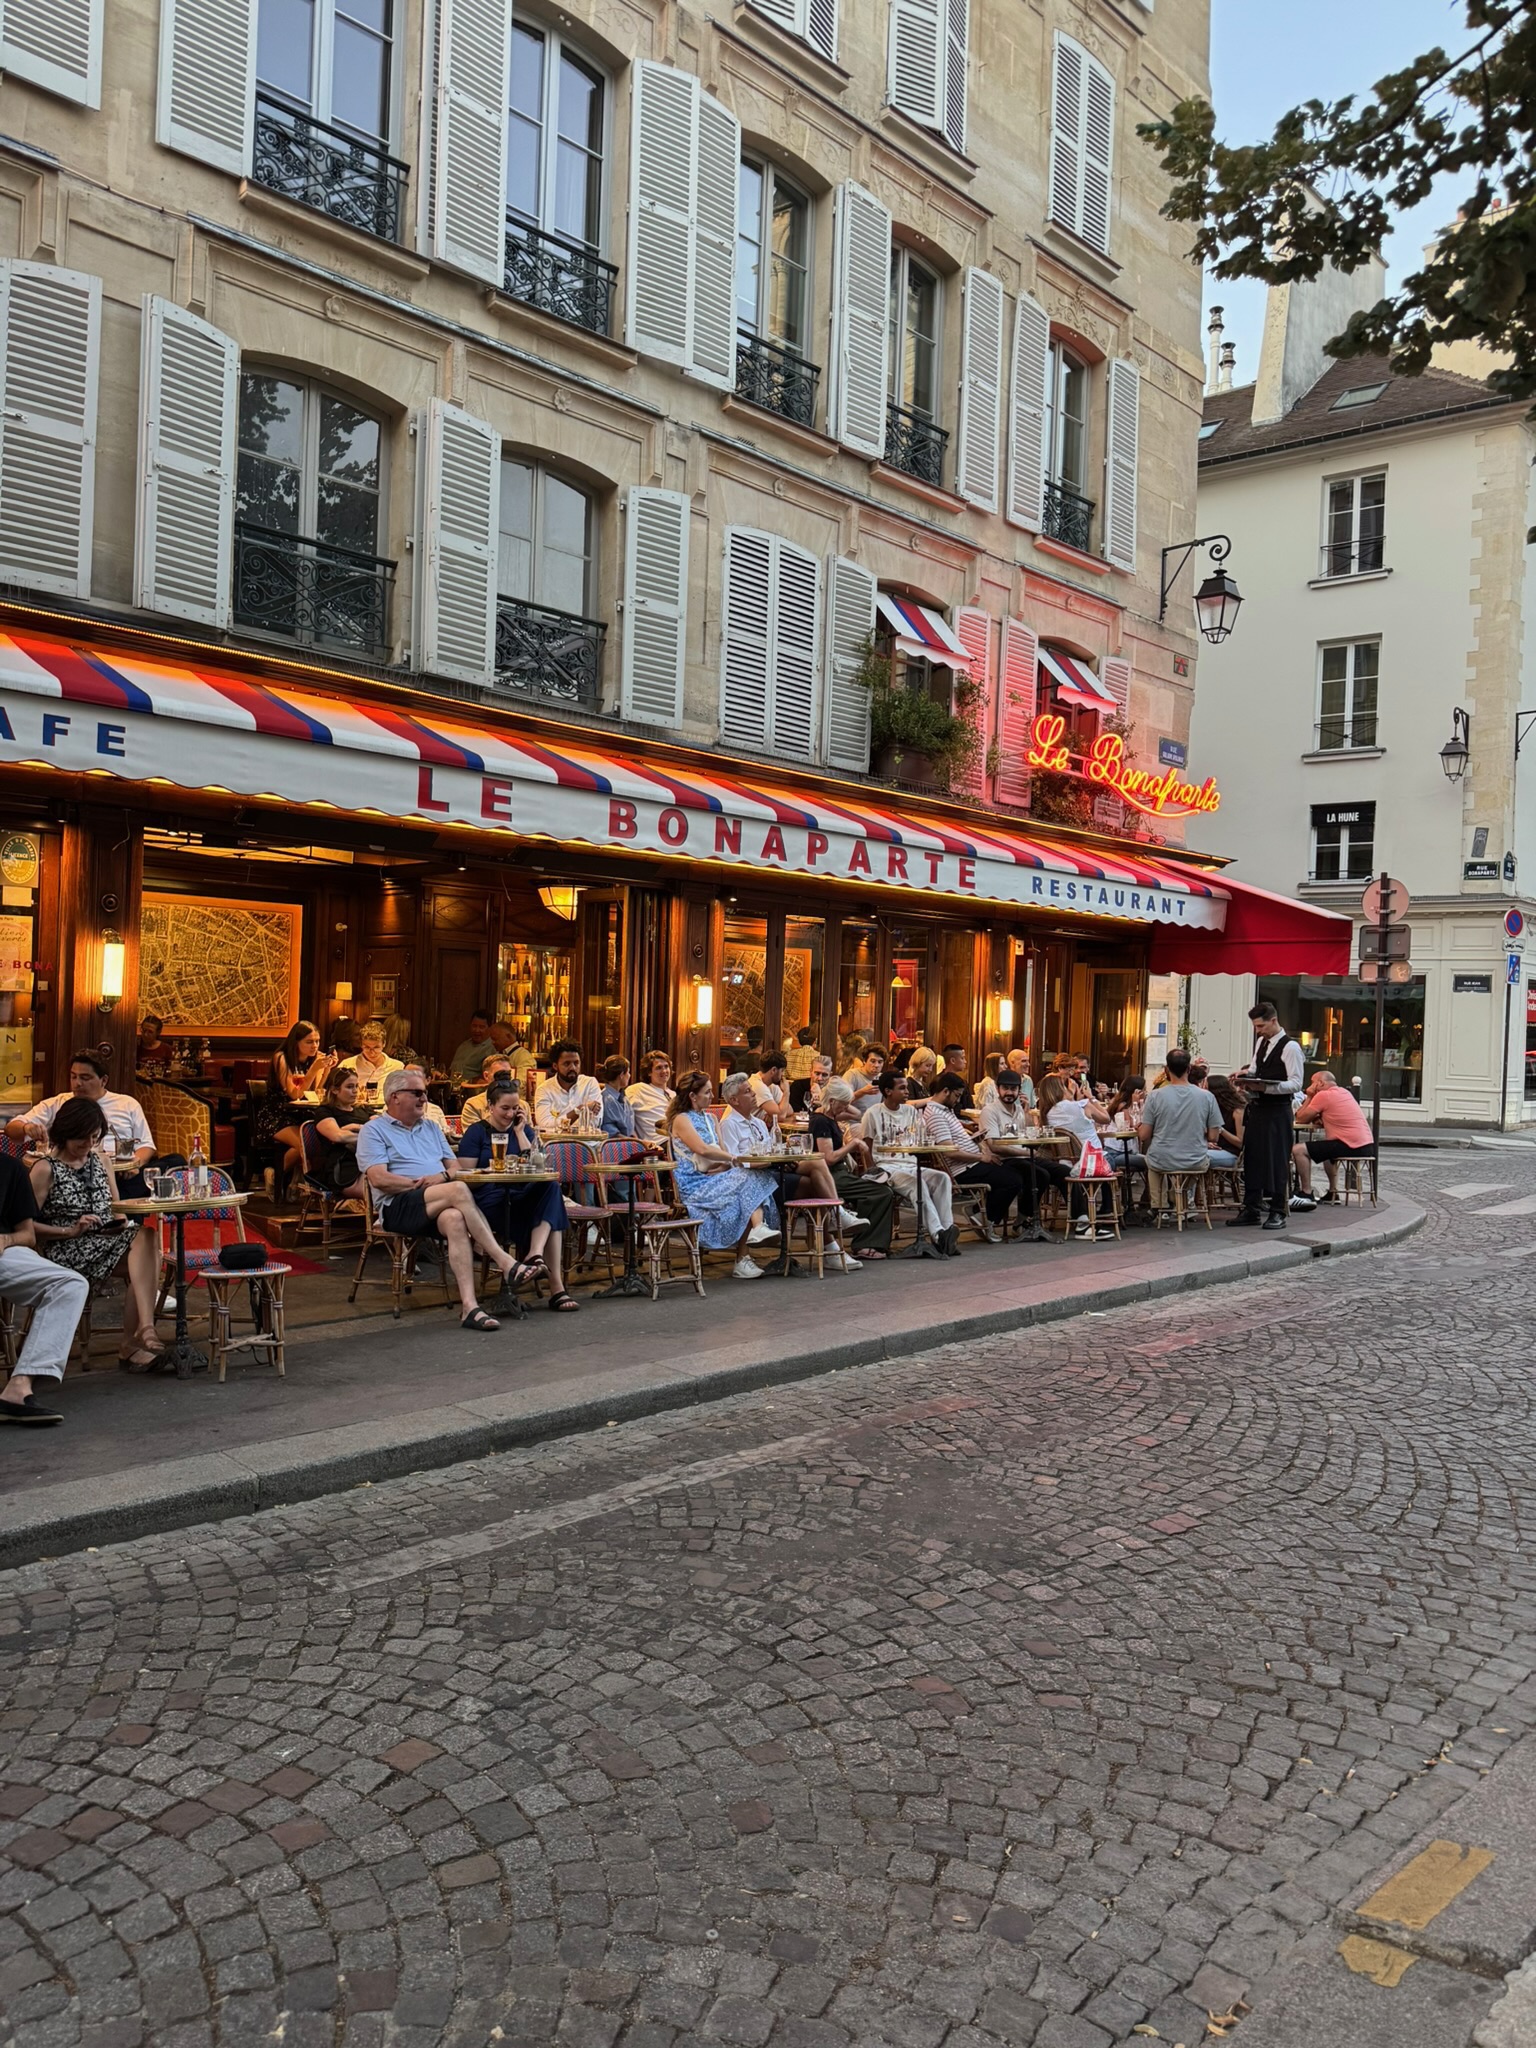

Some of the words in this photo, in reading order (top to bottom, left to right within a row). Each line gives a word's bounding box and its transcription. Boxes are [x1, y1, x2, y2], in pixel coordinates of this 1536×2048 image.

[1027, 714, 1069, 770] Le
[1088, 733, 1221, 818] Bonaparte
[417, 766, 513, 822] LE
[608, 799, 976, 889] BONAPARTE
[1326, 813, 1336, 823] LA
[1338, 811, 1359, 822] HUNE
[1032, 876, 1186, 916] RESTAURANT
